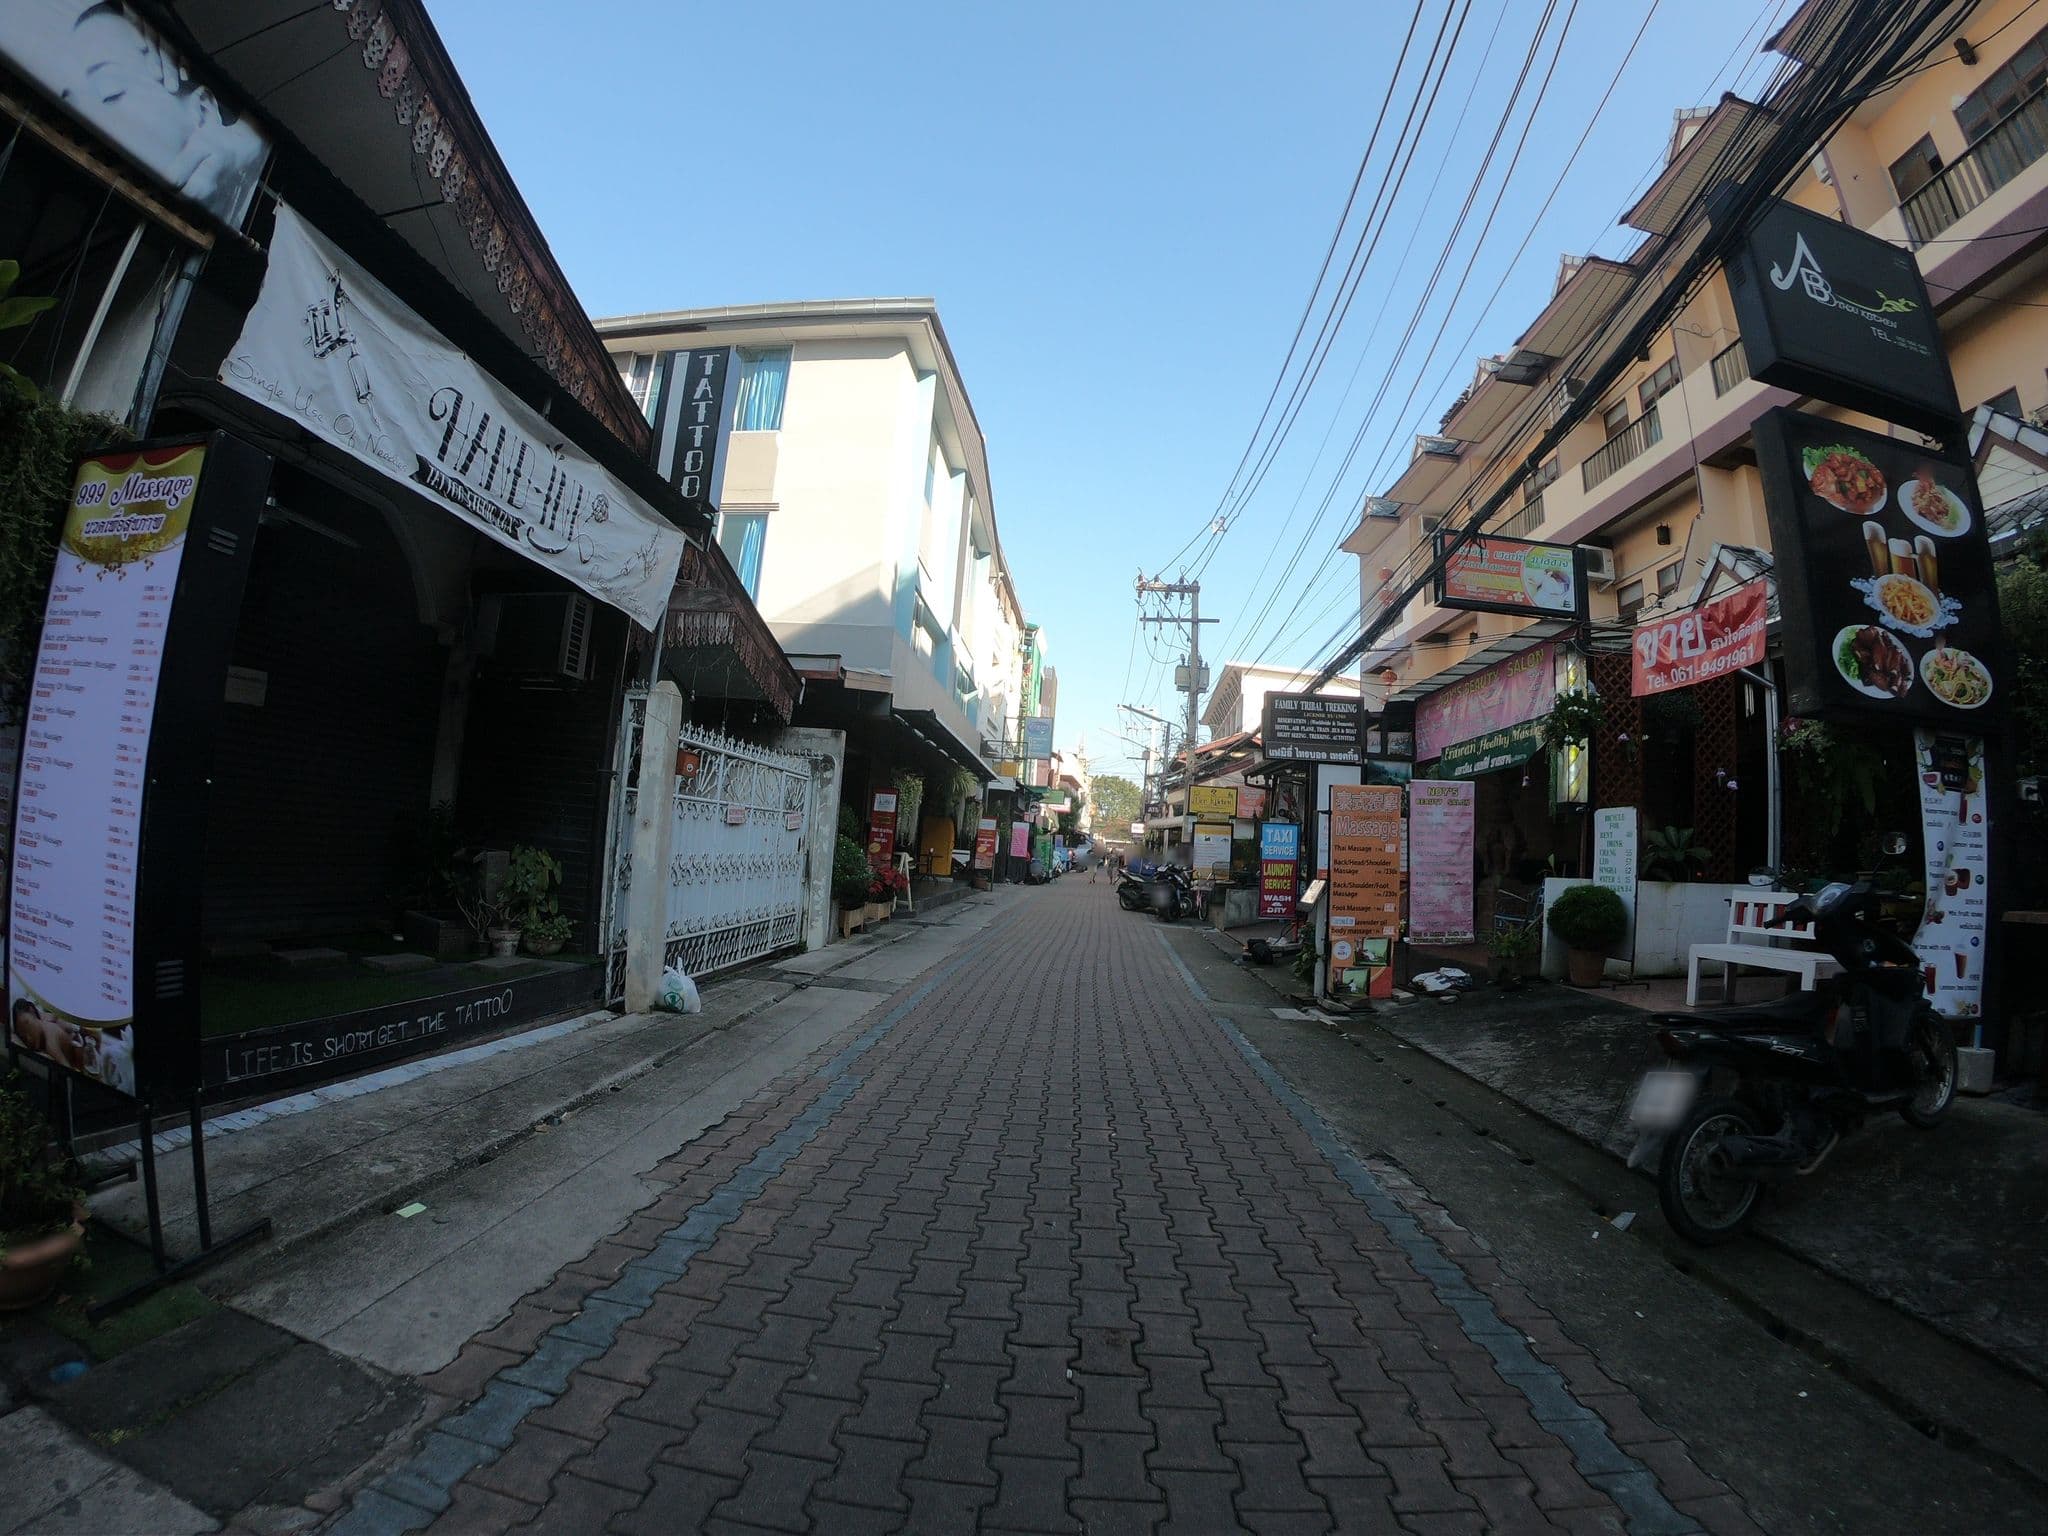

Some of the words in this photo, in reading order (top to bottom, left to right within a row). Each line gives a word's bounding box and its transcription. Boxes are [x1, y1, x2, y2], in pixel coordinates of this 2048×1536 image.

[294, 386, 324, 423] Use
[680, 353, 721, 499] TATTOO
[76, 480, 107, 506] 999
[109, 472, 195, 508] Massage
[83, 508, 165, 540] นวดเพื่อสุขภาพ
[1637, 613, 1707, 669] ขาย
[1465, 668, 1500, 695] BEAUTY
[1506, 649, 1545, 678] SALON
[1647, 672, 1669, 689] Tel:
[1274, 699, 1300, 710] FAMILY
[1300, 701, 1324, 711] TRIBAL
[1325, 703, 1358, 714] TREKKING
[1335, 815, 1399, 842] Massage
[1266, 829, 1294, 844] TAXI
[1263, 846, 1295, 856] SERVICE
[1347, 845, 1372, 854] Massage
[1263, 863, 1294, 877] LAUNDRY
[1333, 867, 1359, 876] Massage
[1264, 879, 1292, 891] SERVICE
[1263, 894, 1293, 902] WASH
[1332, 891, 1358, 899] Massage
[1346, 905, 1371, 913] Massage
[224, 1045, 282, 1082] LIFE
[289, 1041, 313, 1066] IS
[322, 1030, 375, 1059] SHORT
[377, 1021, 409, 1046] GET
[416, 1010, 448, 1035] THE
[455, 987, 514, 1025] TATTOO
